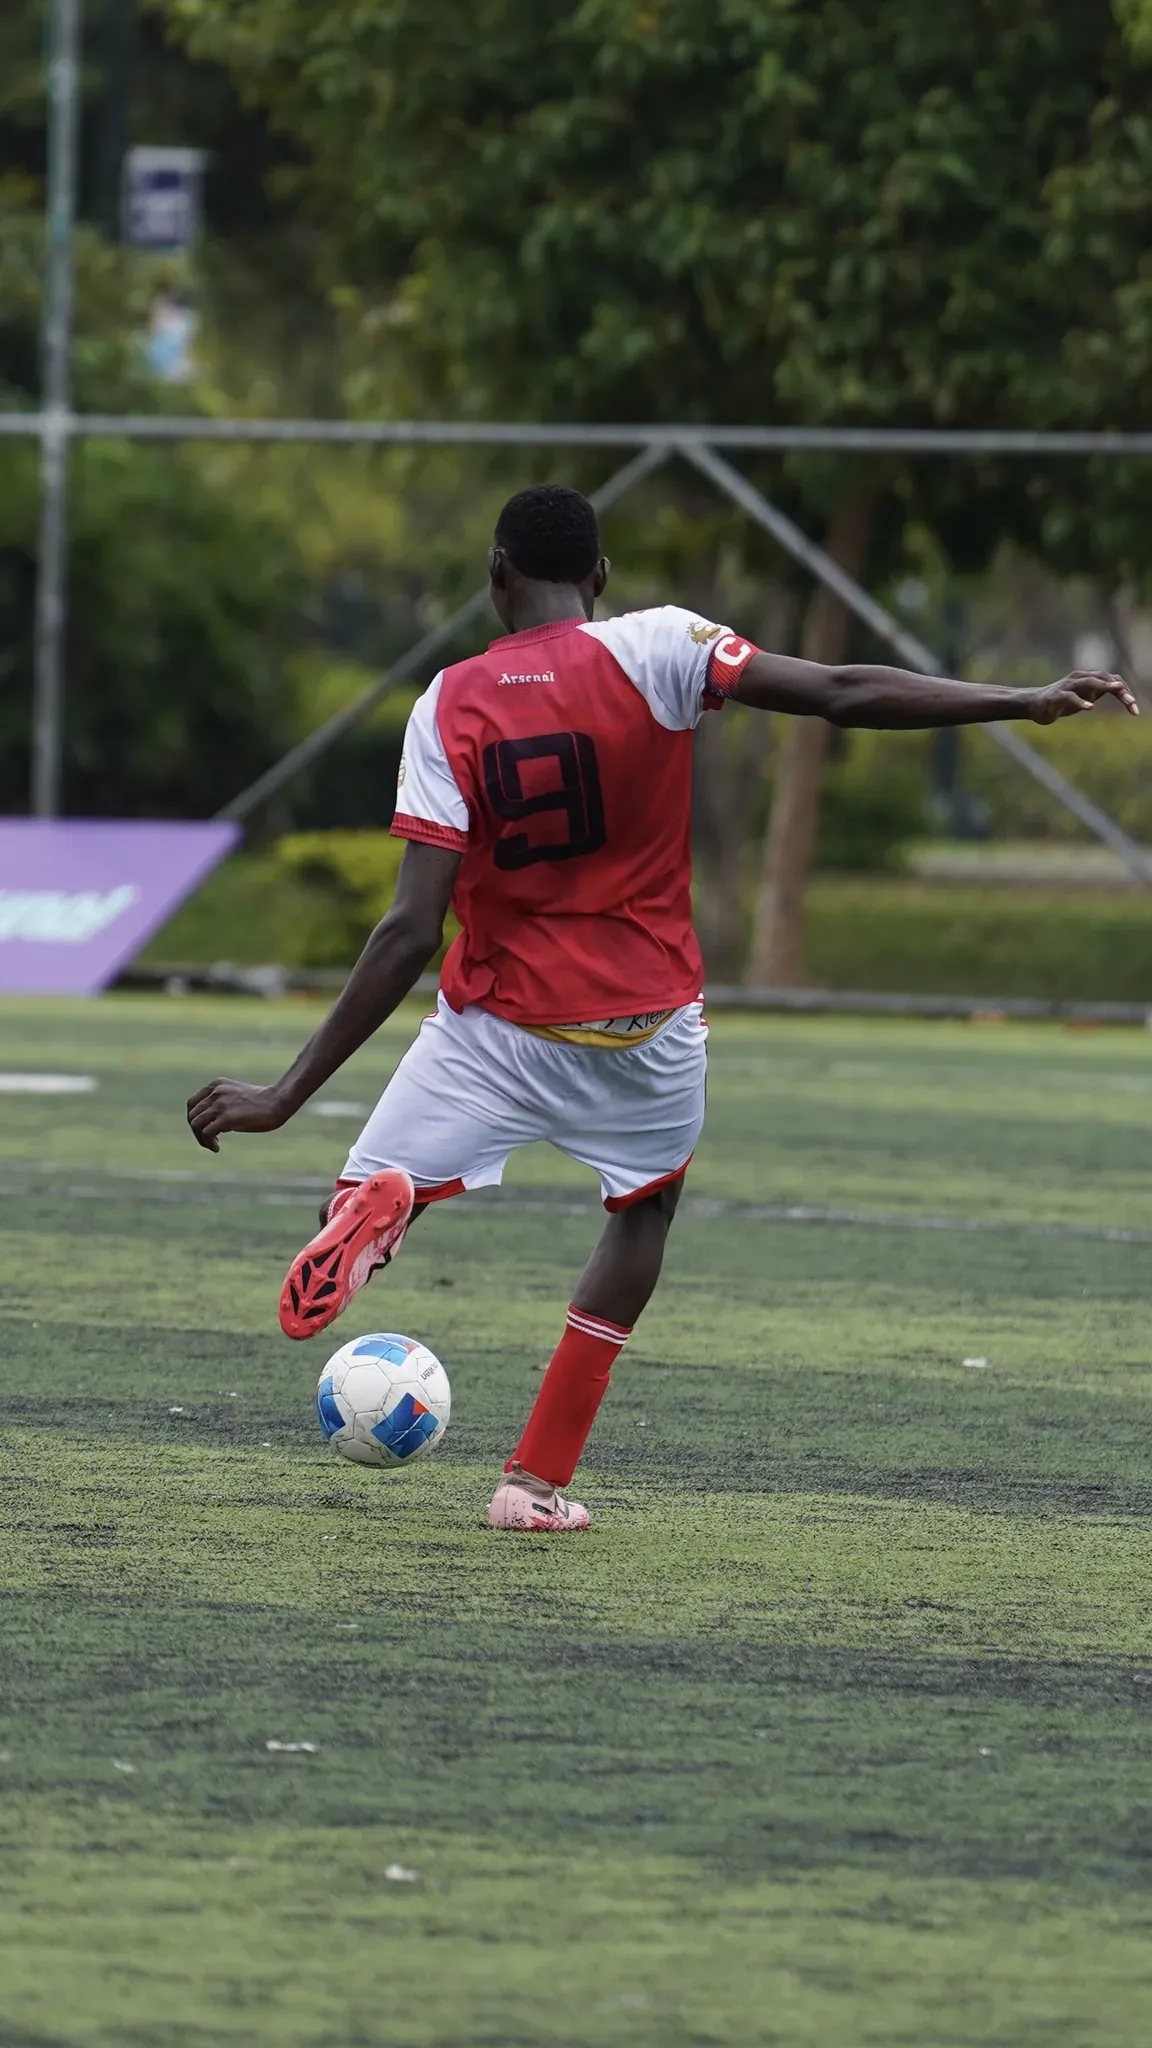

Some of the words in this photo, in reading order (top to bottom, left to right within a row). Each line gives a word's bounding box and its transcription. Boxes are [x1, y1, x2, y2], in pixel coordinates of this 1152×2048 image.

[714, 636, 752, 667] C
[497, 670, 555, 687] Arsenal
[482, 731, 607, 872] 9
